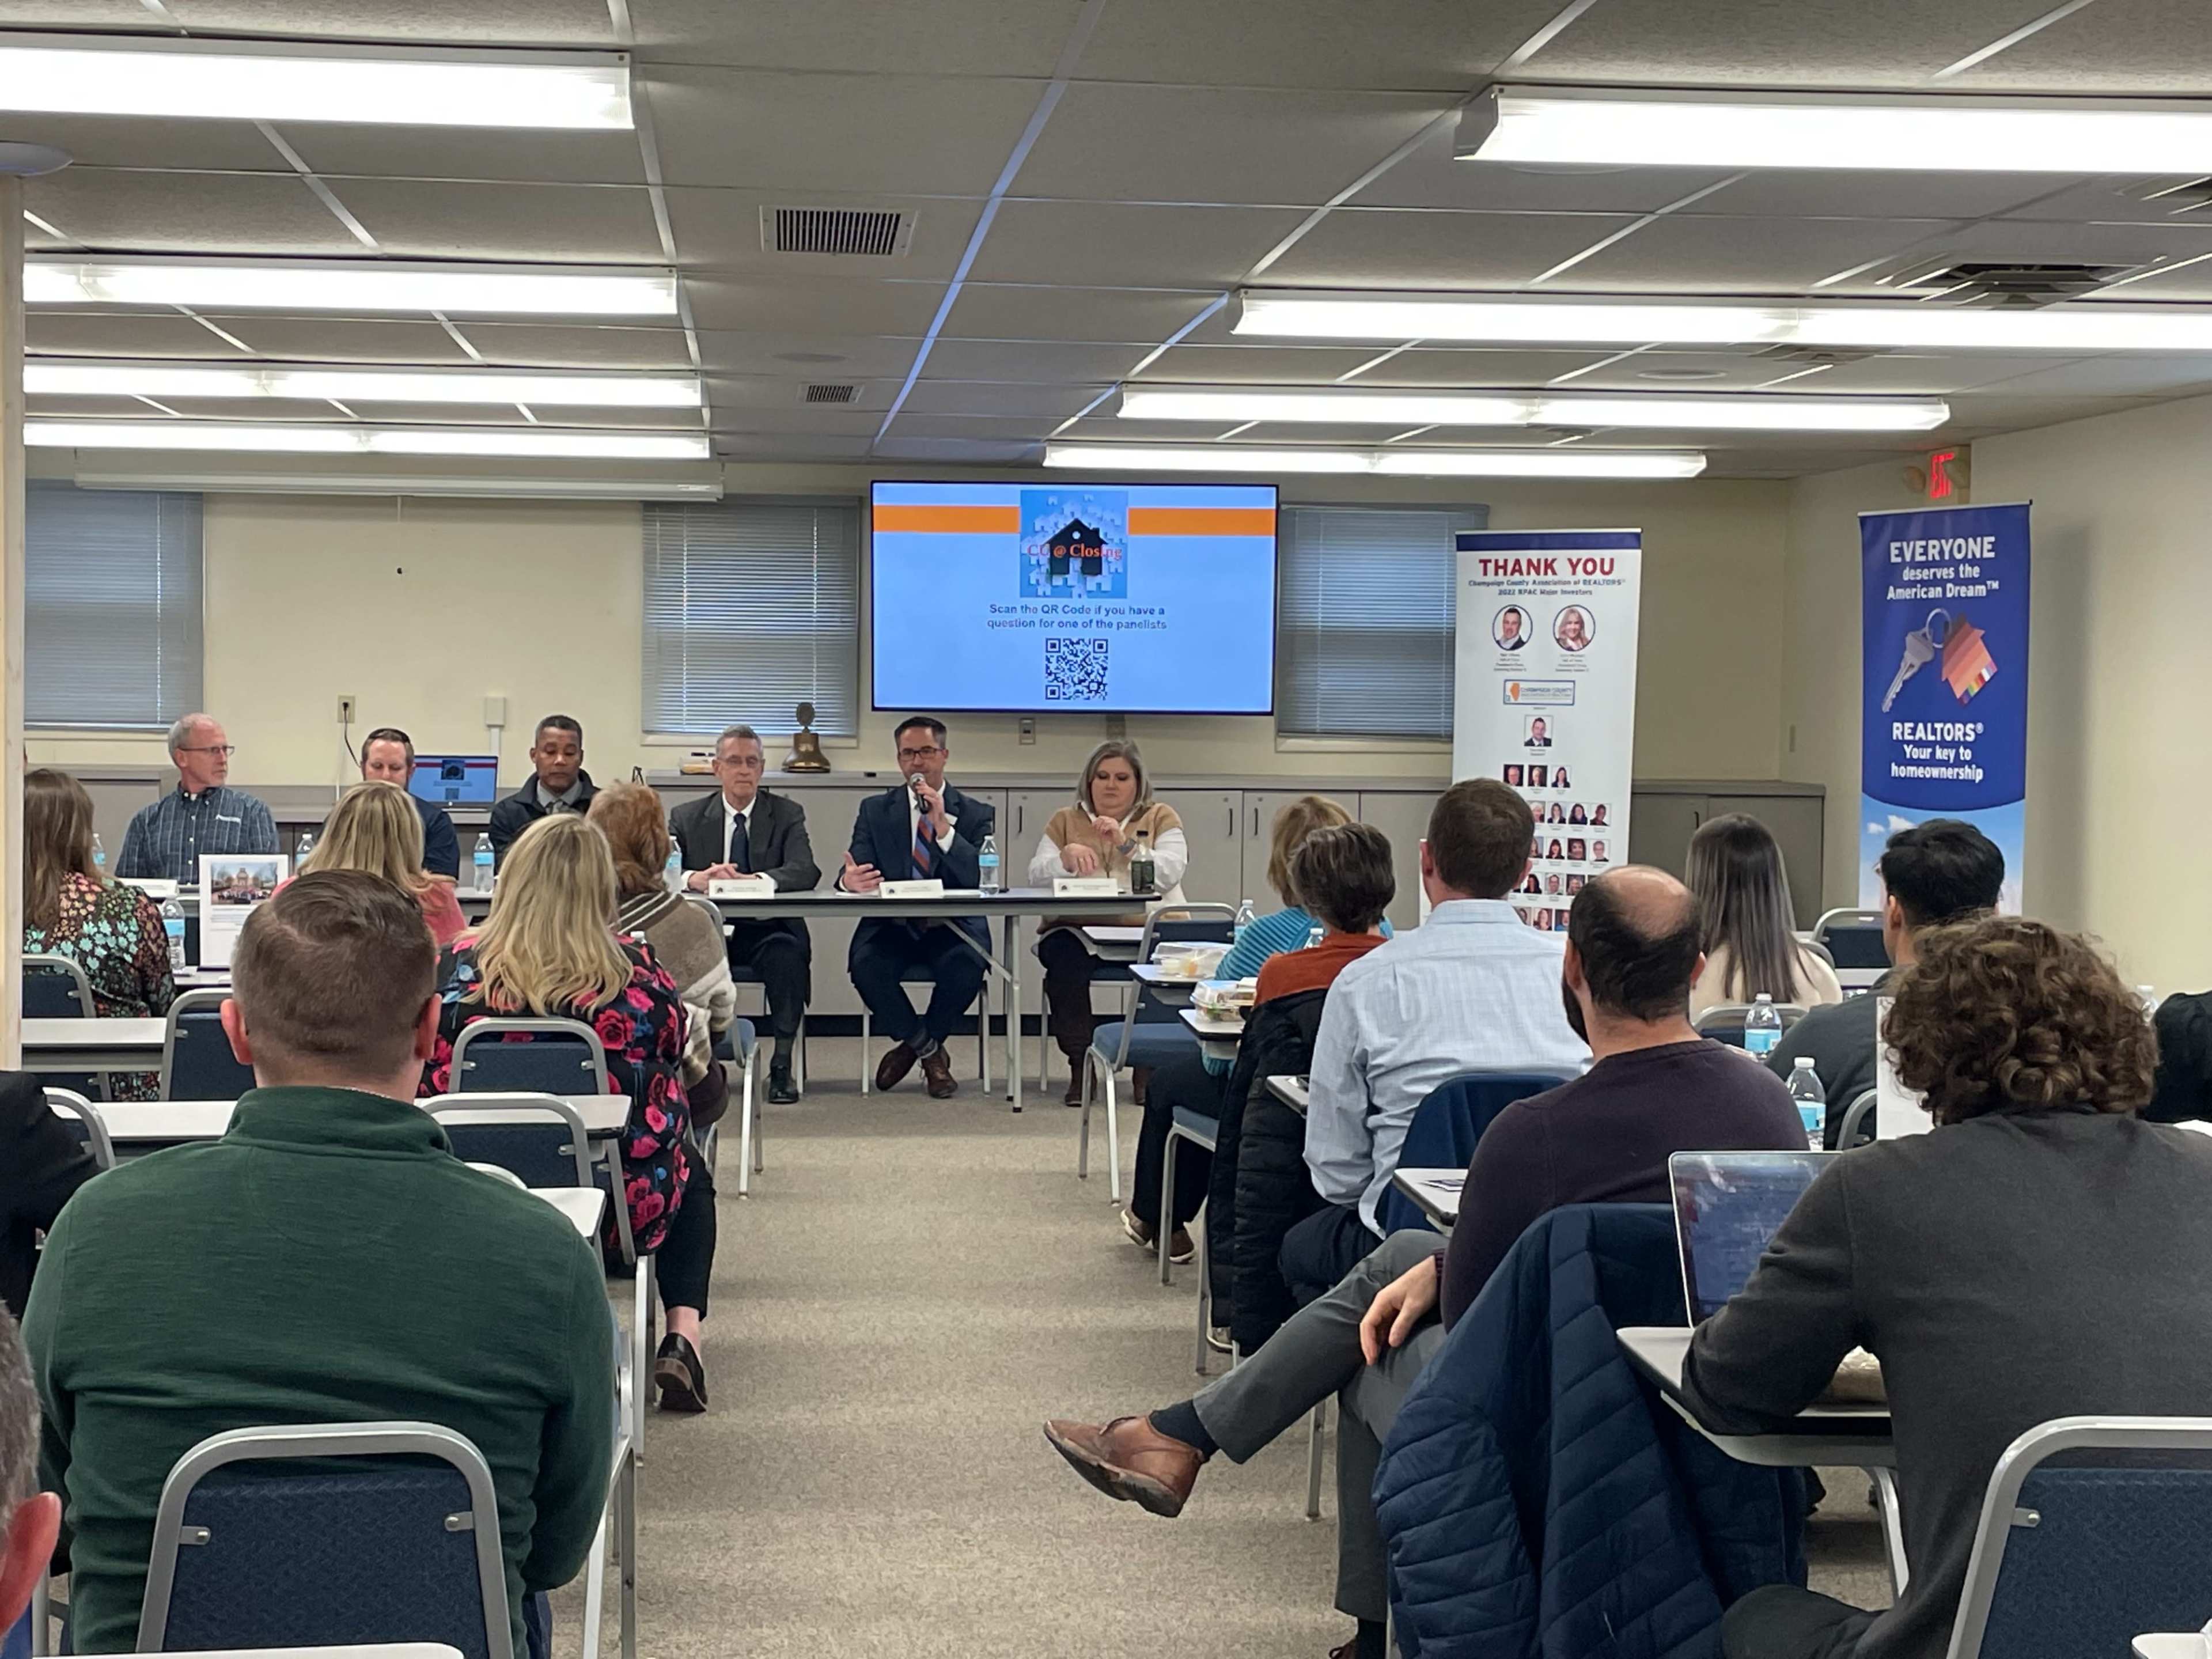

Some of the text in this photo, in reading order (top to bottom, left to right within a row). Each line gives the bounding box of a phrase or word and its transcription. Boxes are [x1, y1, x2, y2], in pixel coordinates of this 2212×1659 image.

[1053, 545, 1066, 558] @
[1069, 543, 1122, 560] Closing
[1890, 536, 1995, 563] EVERYONE
[1479, 558, 1615, 577] THANK YOU
[1903, 563, 1980, 581] deserves the
[1887, 584, 1942, 600] American
[989, 604, 1017, 614] Scan
[1020, 604, 1037, 614] the
[1041, 604, 1059, 614] QR
[1062, 604, 1091, 615] Code
[1094, 605, 1101, 615] if
[1104, 607, 1125, 617] you
[1128, 605, 1156, 615] have
[987, 618, 1167, 631] question for one of the panelists
[1903, 744, 1972, 764] Your key to
[1891, 762, 1984, 783] homeownership
